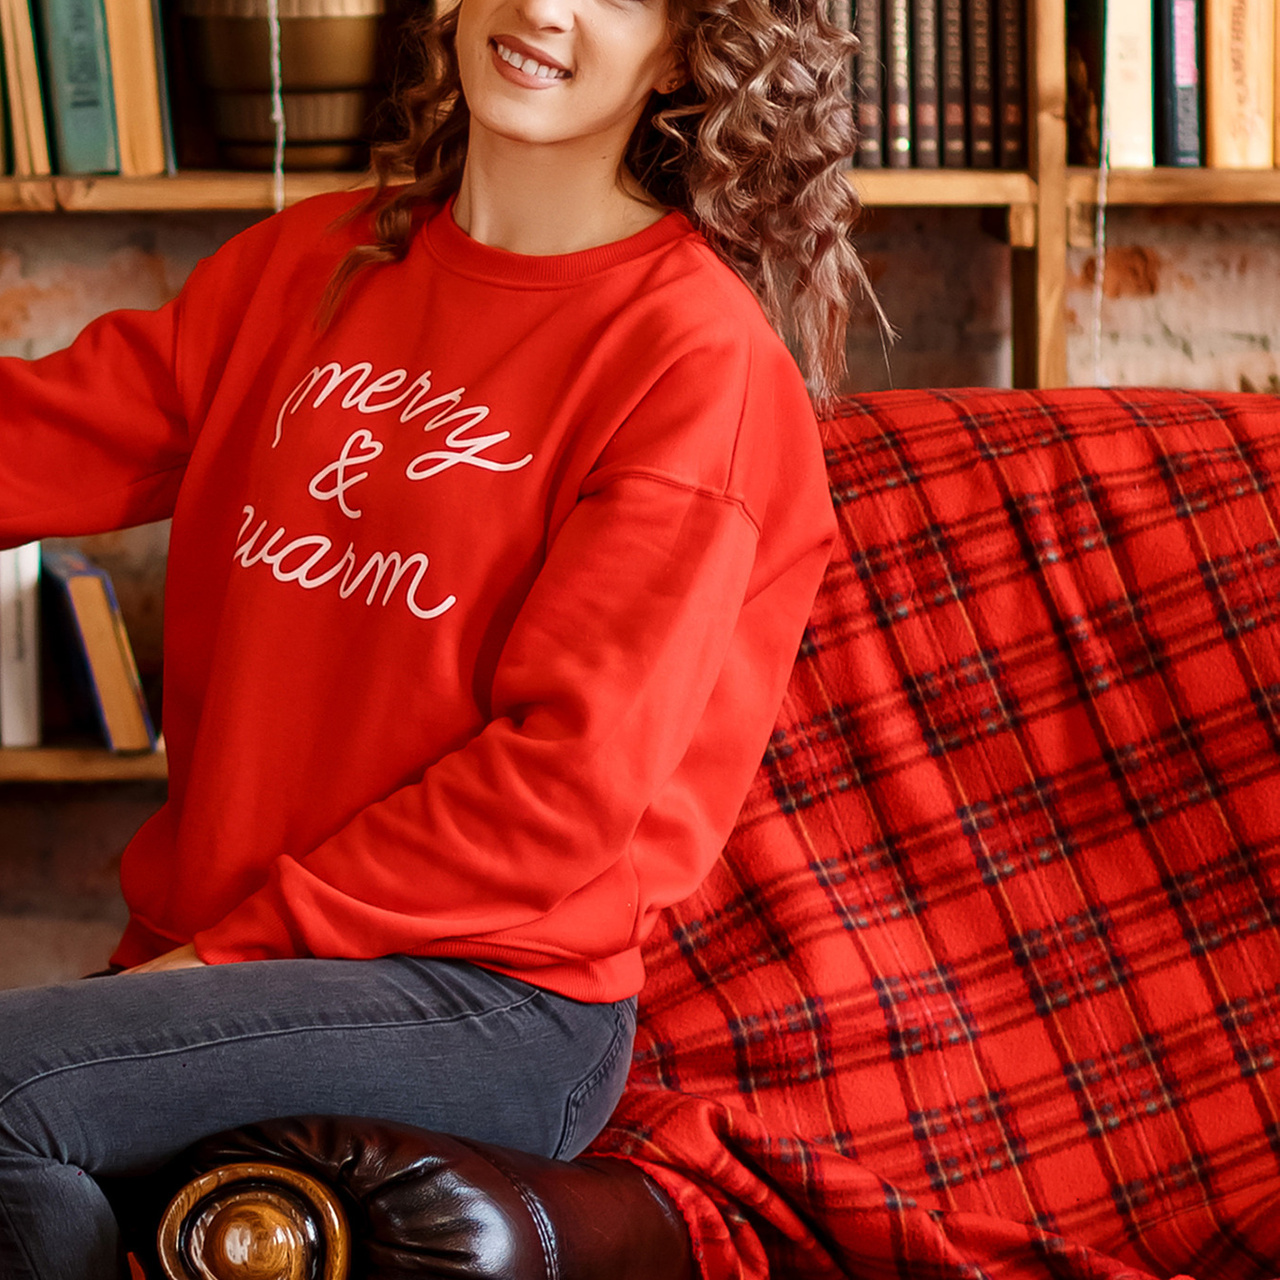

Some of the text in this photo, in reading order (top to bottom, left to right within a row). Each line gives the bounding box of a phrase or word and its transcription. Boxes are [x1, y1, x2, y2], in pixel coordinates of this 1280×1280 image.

[272, 362, 533, 480] merry
[308, 429, 384, 519] &
[232, 505, 457, 619] warm
